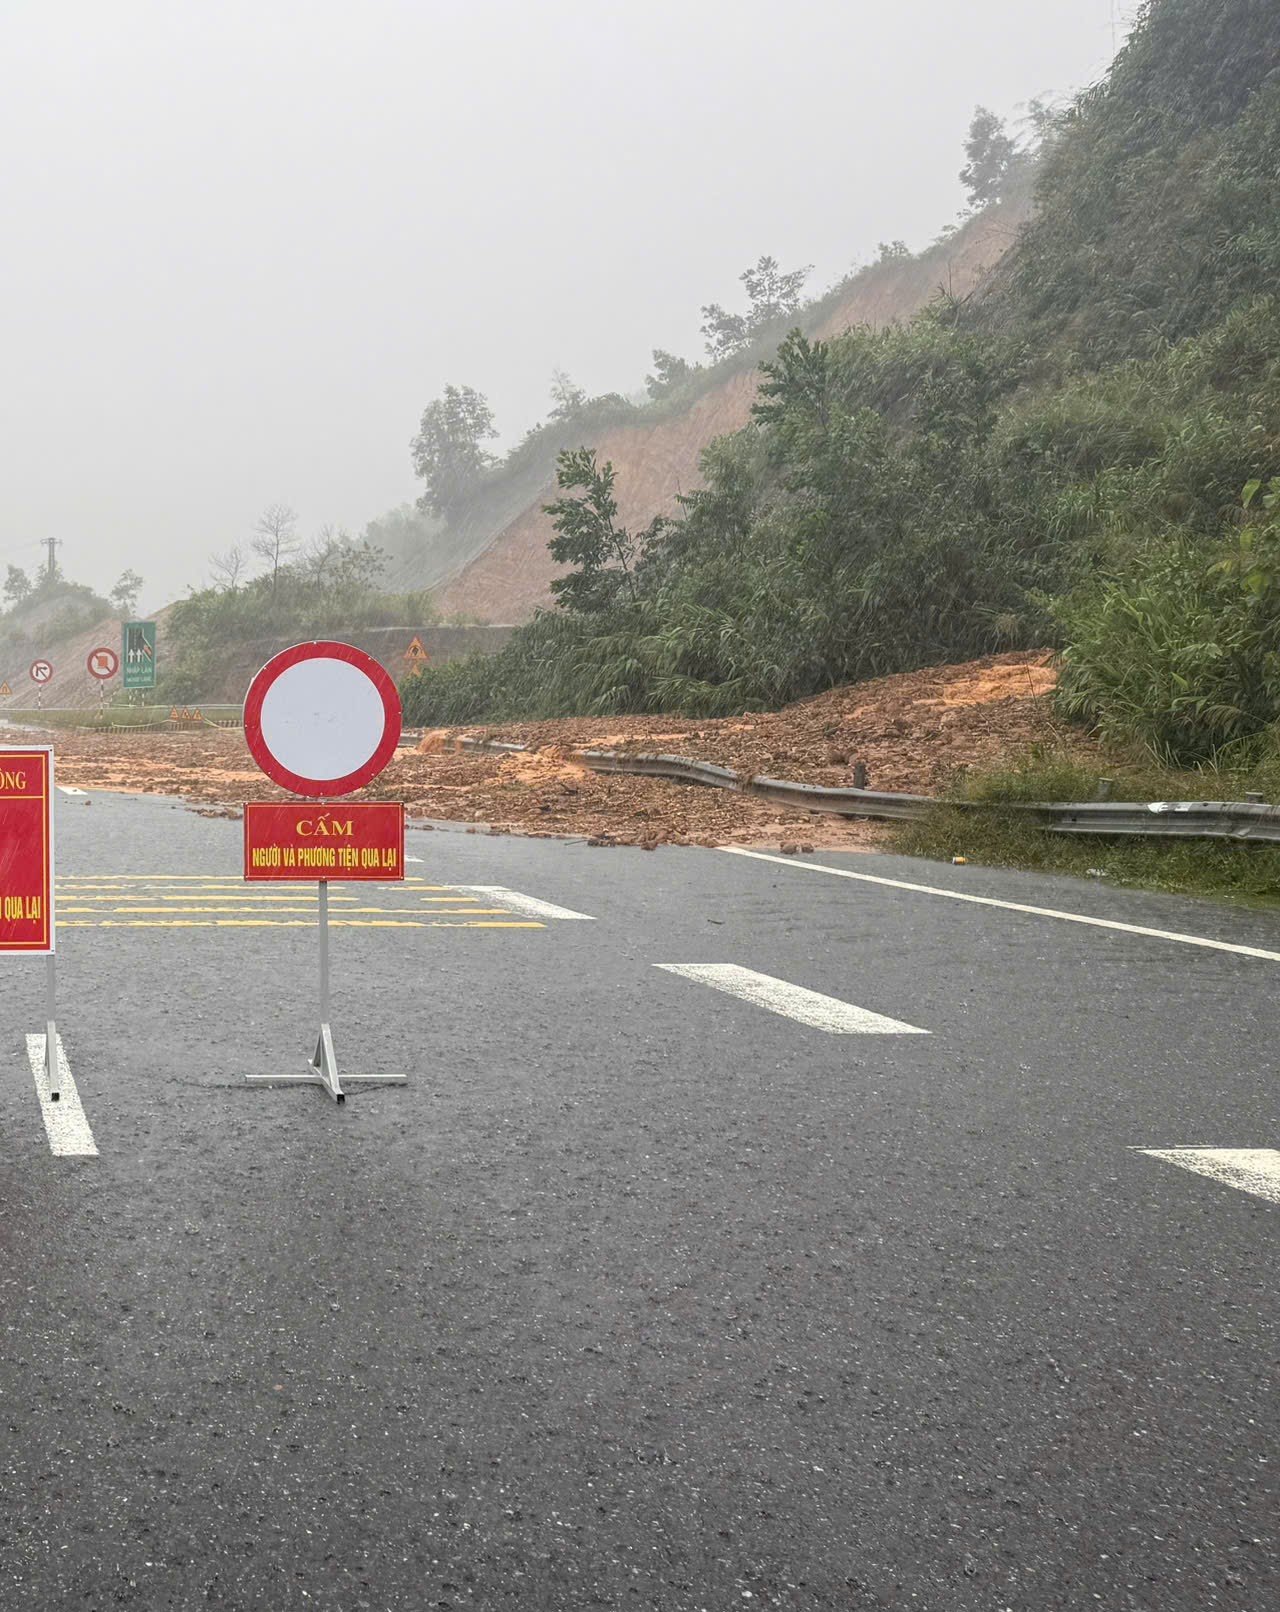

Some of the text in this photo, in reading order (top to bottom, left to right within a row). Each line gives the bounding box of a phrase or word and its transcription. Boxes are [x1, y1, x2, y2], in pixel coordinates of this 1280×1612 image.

[296, 813, 354, 836] CẤM
[253, 843, 396, 871] NGƯỜI VÀ PHƯƠNG TIỆN QUA LẠI
[5, 896, 23, 920] QUA
[26, 895, 40, 923] LẠI
